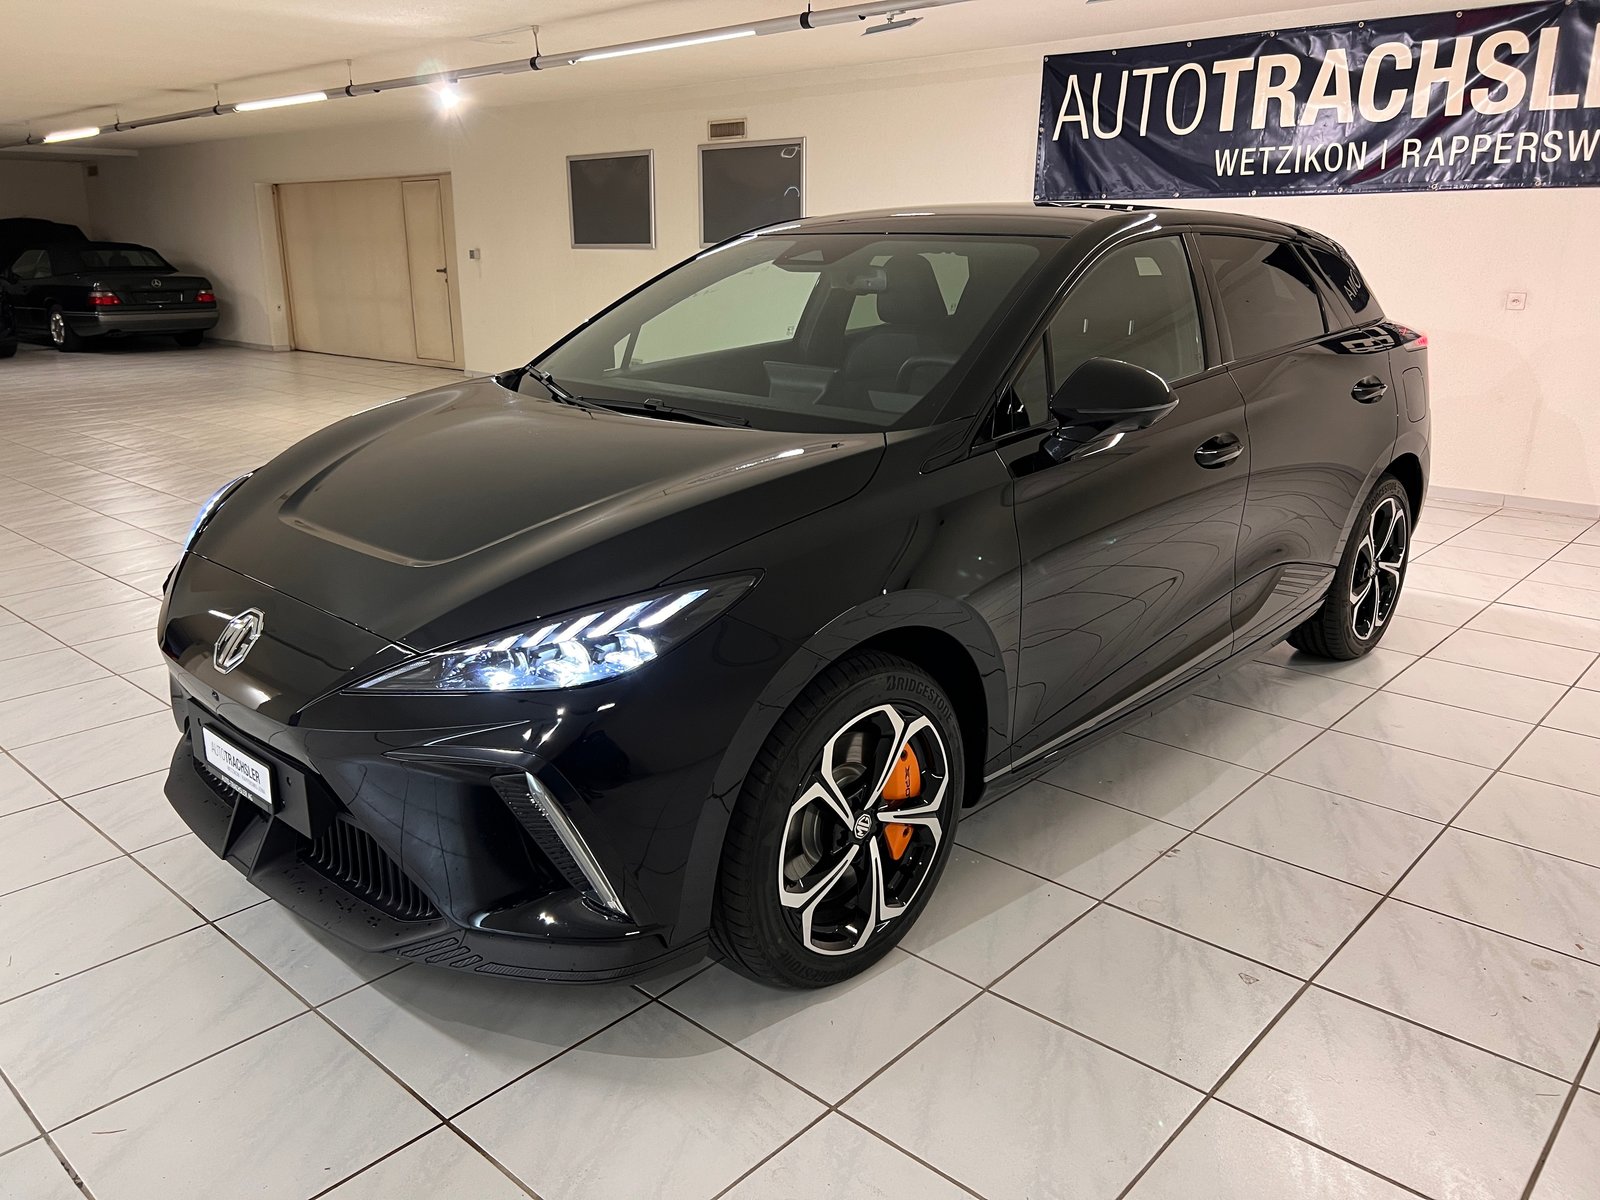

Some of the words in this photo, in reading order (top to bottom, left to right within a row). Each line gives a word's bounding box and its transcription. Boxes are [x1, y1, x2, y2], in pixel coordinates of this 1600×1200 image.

[1215, 142, 1366, 176] WETZIKON
[1402, 130, 1600, 168] RAPPERSW
[216, 611, 260, 668] MG
[886, 675, 954, 721] BRIDGESTONE
[211, 741, 261, 784] AUTOTRACHSLER
[856, 815, 870, 837] MG
